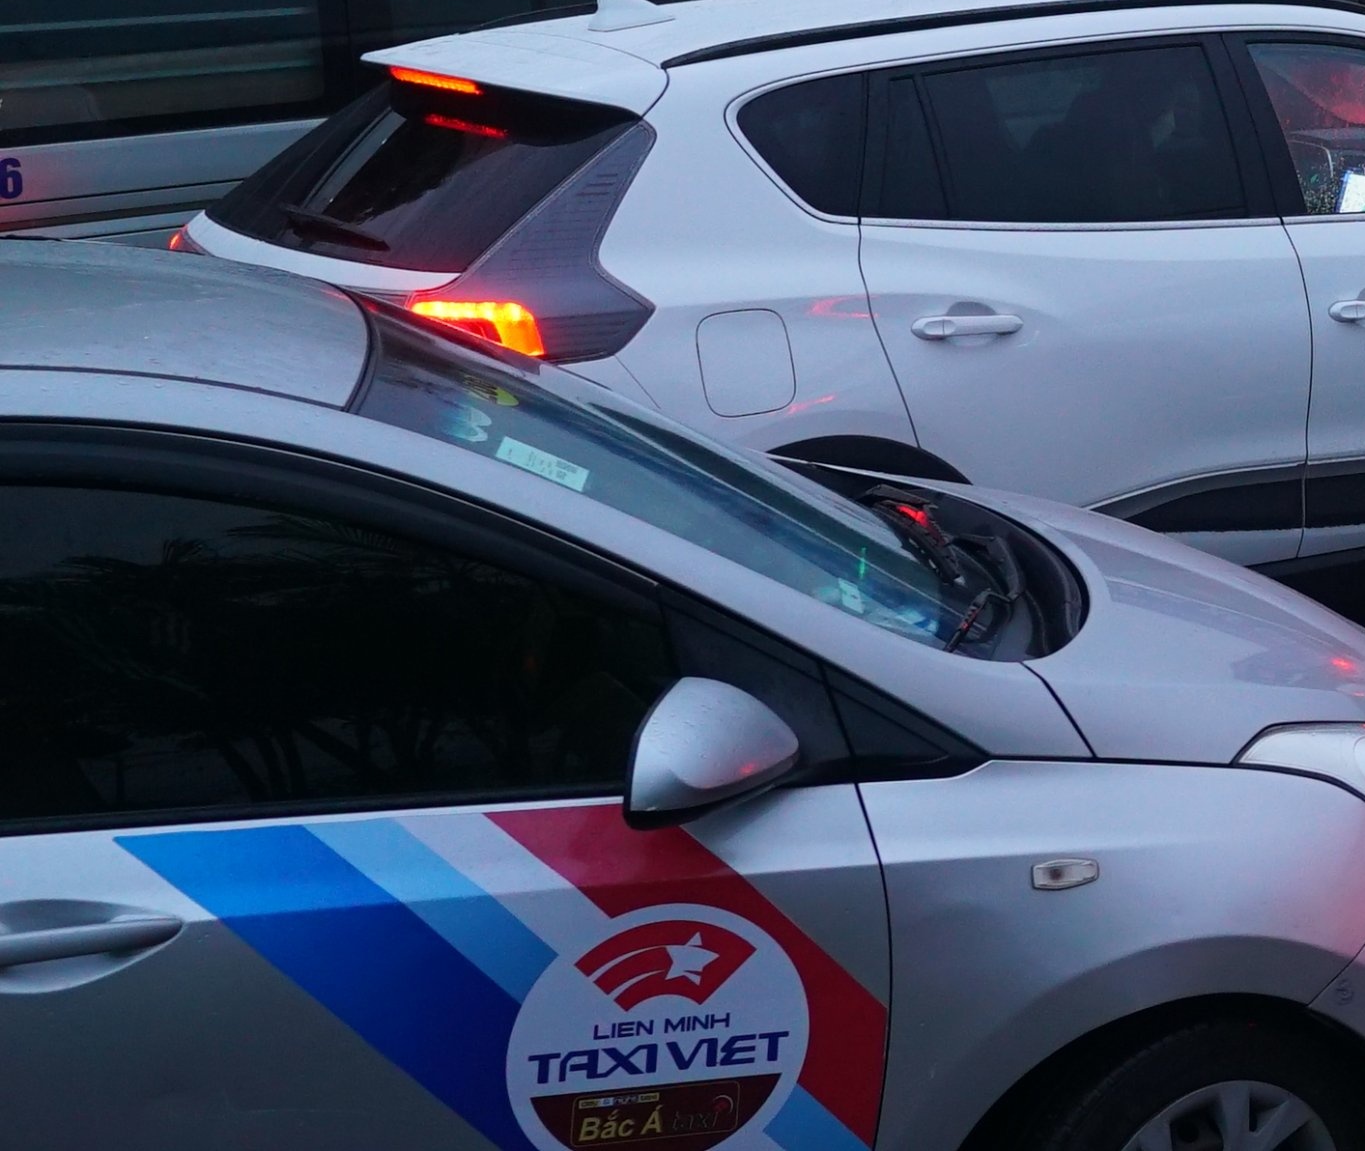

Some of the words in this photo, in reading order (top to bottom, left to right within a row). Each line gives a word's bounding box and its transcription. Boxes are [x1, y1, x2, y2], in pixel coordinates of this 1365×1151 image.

[593, 1019, 654, 1041] LIEN
[663, 1012, 732, 1035] MINH
[527, 1046, 660, 1085] TAXI
[664, 1030, 790, 1069] VIET
[577, 1109, 636, 1142] Bắc
[640, 1104, 664, 1135] Á
